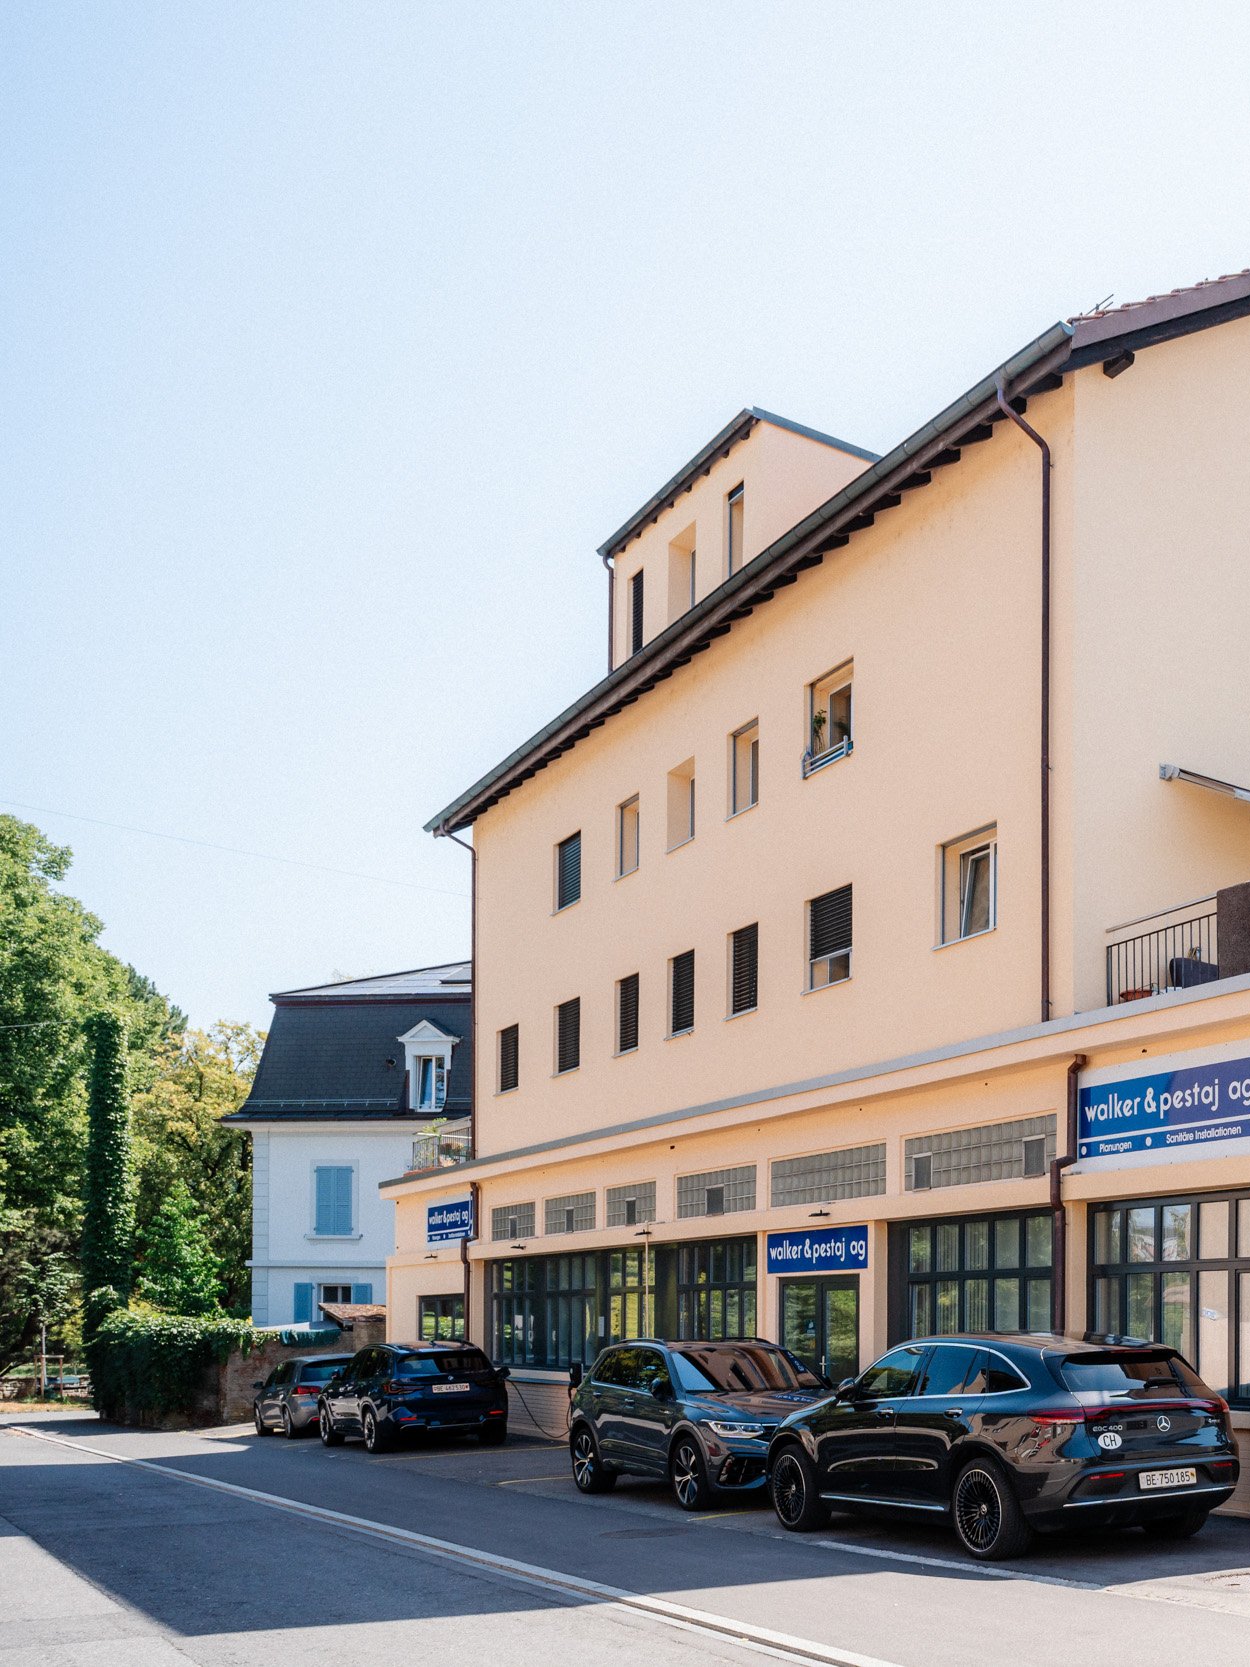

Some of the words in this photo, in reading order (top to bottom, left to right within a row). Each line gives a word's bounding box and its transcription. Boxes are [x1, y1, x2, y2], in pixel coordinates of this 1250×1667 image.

[1084, 1092, 1141, 1123] walker
[1144, 1087, 1157, 1113] &
[1160, 1078, 1219, 1120] pestaj
[1166, 1131, 1194, 1144] Sanitäre
[1195, 1125, 1242, 1140] Installationen
[1099, 1141, 1132, 1153] Planungen
[769, 1240, 802, 1261] walker
[803, 1238, 812, 1258] &
[812, 1237, 846, 1264] pestaj
[850, 1240, 866, 1261] ag
[1102, 1434, 1118, 1448] CH
